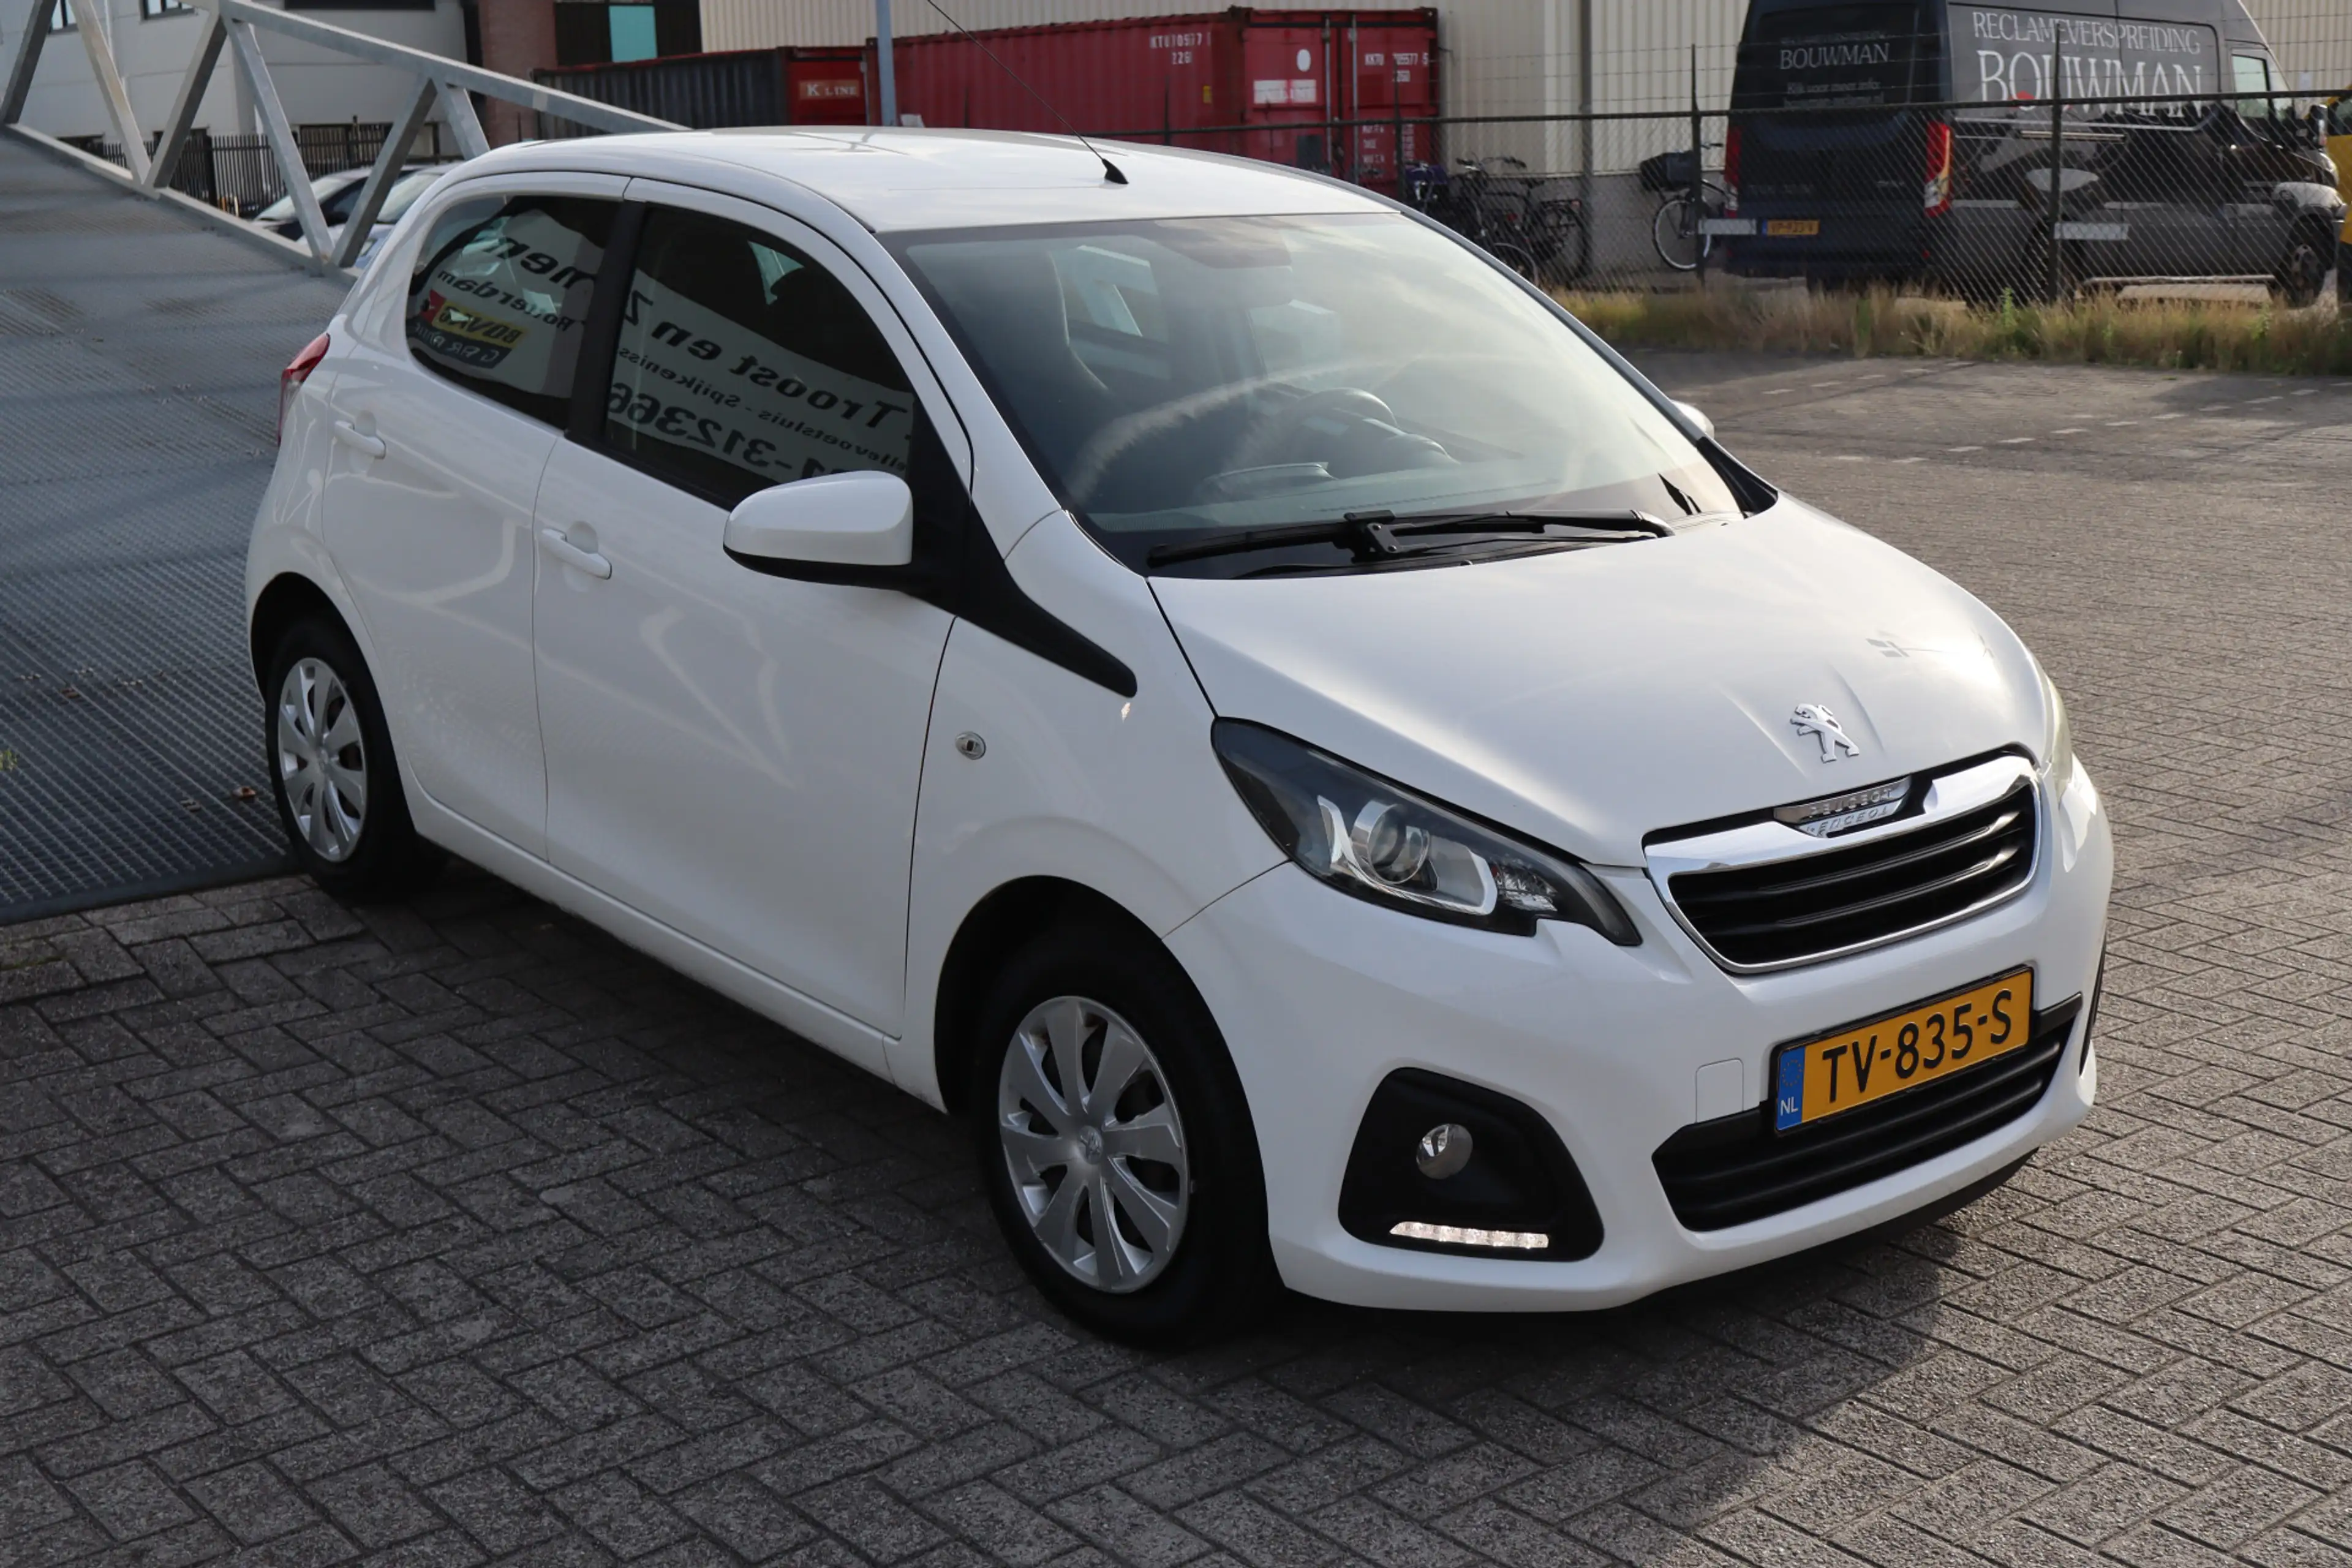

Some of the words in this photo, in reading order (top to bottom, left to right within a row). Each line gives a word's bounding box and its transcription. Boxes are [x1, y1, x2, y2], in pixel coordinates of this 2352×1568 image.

[1779, 42, 1890, 70] BOUWMAN
[807, 84, 820, 97] K
[824, 86, 857, 96] LINE
[1976, 49, 2203, 119] BOUWMAN
[1822, 988, 2011, 1103] TV-835-S
[1779, 1096, 1800, 1115] NL
